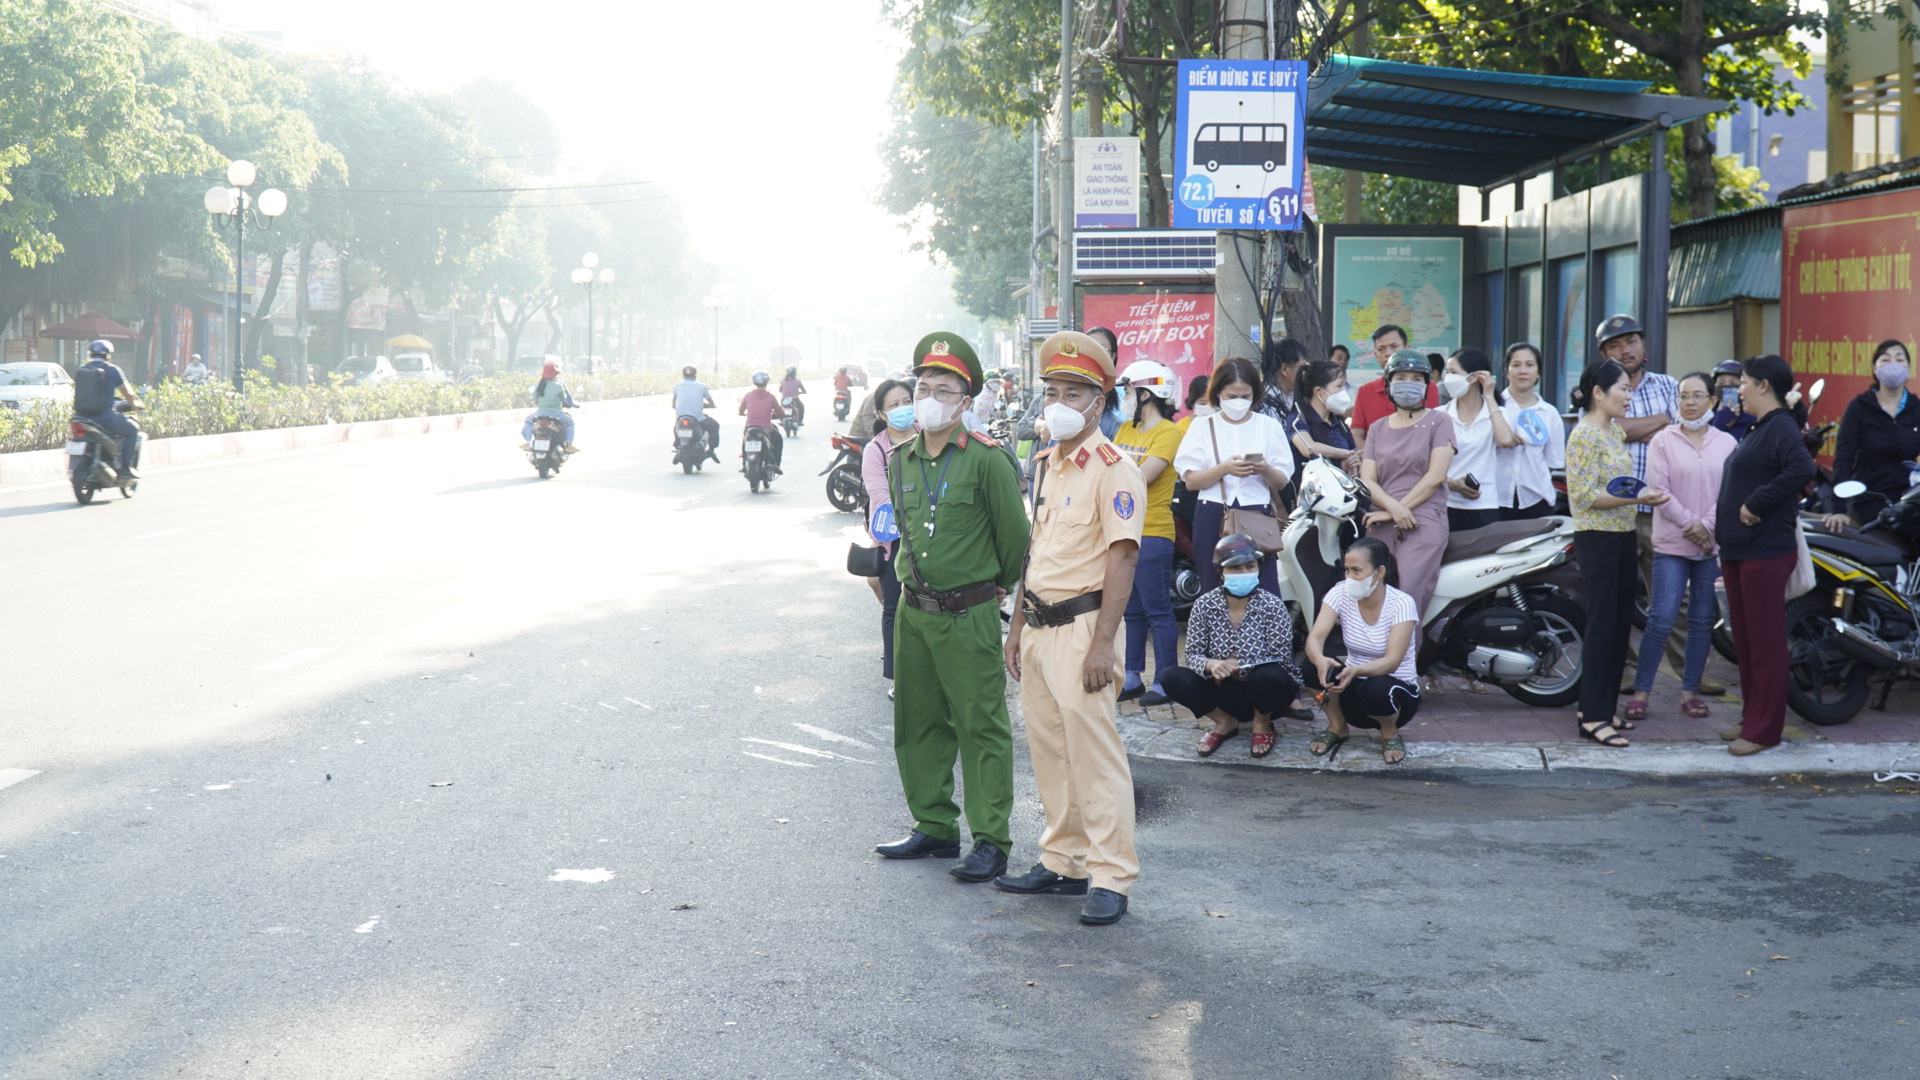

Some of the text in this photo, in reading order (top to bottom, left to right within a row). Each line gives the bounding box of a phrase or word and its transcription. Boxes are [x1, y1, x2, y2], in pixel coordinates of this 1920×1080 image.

[1189, 65, 1299, 87] ĐIỂM DỪNG XE BUÝT
[1092, 162, 1122, 171] AN TOÀN
[1086, 174, 1128, 183] GIAO THÔNG
[1082, 186, 1091, 195] LÀ
[1113, 186, 1132, 195] PHÚC
[1182, 182, 1213, 201] 72.1
[1197, 203, 1233, 224] TUYẾN
[1239, 203, 1257, 224] SỐ
[1257, 209, 1265, 224] 4
[1269, 194, 1299, 217] 611
[1869, 247, 1893, 292] CHÁY
[1128, 299, 1196, 317] TIẾT KIỆM
[1114, 320, 1128, 328] CHI
[1129, 317, 1145, 327] PHÍ
[1176, 314, 1194, 323] CÁO
[1195, 312, 1210, 321] VỚI
[1117, 324, 1210, 346] IGHT BOX
